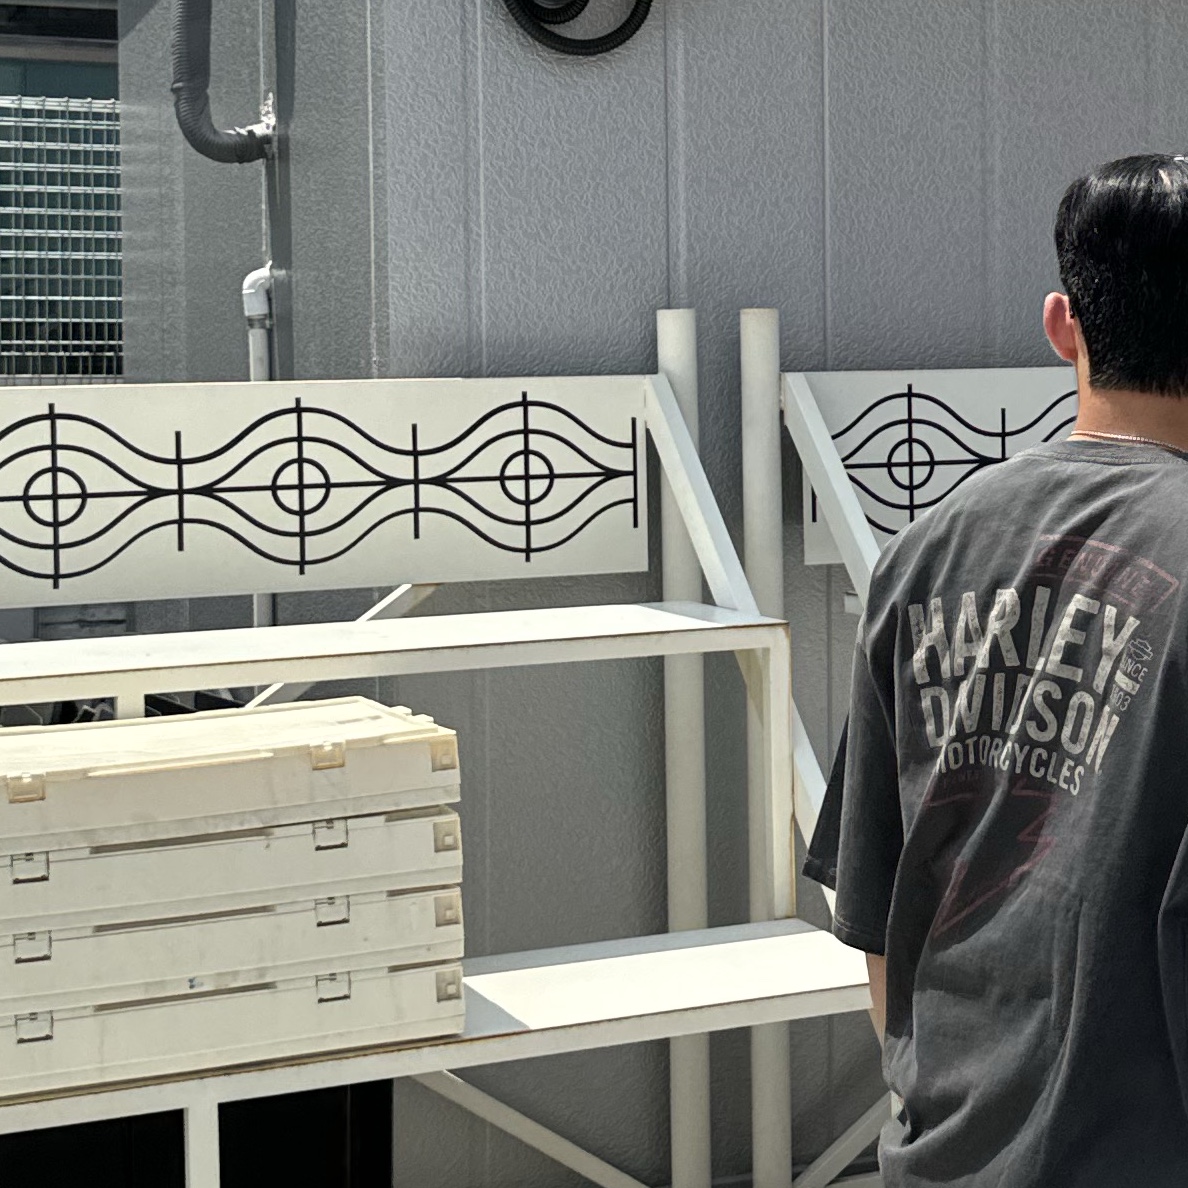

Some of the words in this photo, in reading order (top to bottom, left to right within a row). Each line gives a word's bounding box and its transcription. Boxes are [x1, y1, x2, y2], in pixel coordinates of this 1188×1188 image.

[907, 584, 1141, 695] HARLEY
[1120, 654, 1149, 683] NCE
[1109, 684, 1132, 712] 03
